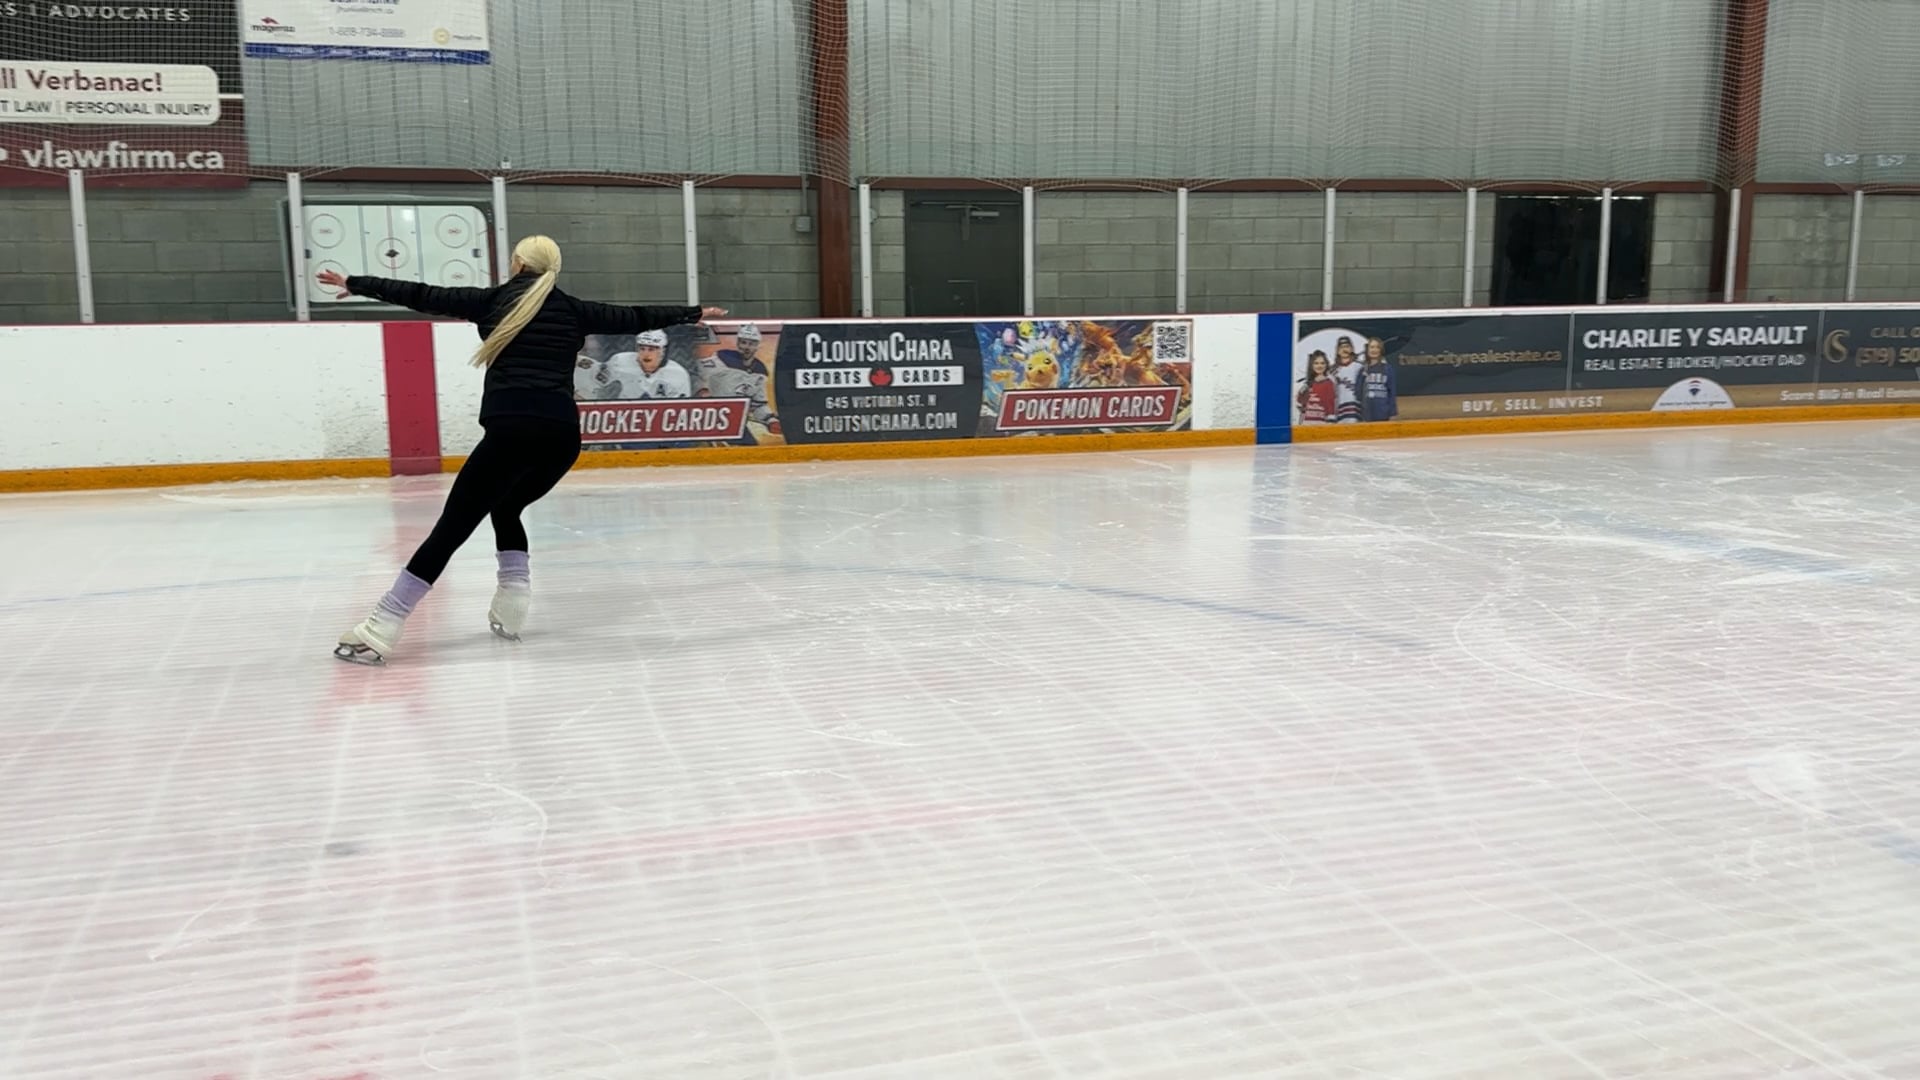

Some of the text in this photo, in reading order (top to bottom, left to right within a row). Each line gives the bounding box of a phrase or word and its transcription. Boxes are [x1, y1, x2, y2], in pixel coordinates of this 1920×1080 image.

[49, 4, 191, 21] ADVOCATES
[25, 68, 163, 91] Verbanac!
[14, 100, 51, 113] LAW
[66, 101, 212, 115] PERSONAL INJURY
[21, 140, 225, 169] vlawfirm.ca
[1583, 325, 1808, 349] CHARLIE Y SARAULT
[1870, 326, 1907, 338] CALL
[1400, 350, 1562, 367] twincityrealestate.ca
[1584, 359, 1616, 371] REAL
[1620, 357, 1664, 370] ESTATE
[802, 369, 950, 384] SPORTS CARDS
[825, 396, 849, 409] 645
[852, 396, 904, 408] VICTORIA
[907, 395, 924, 407] ST.
[1012, 395, 1165, 422] POKEMON CARDS
[1548, 396, 1604, 409] INVEST
[662, 407, 731, 431] CARDS
[804, 412, 958, 434] CLOUTSNCHARA.COM
